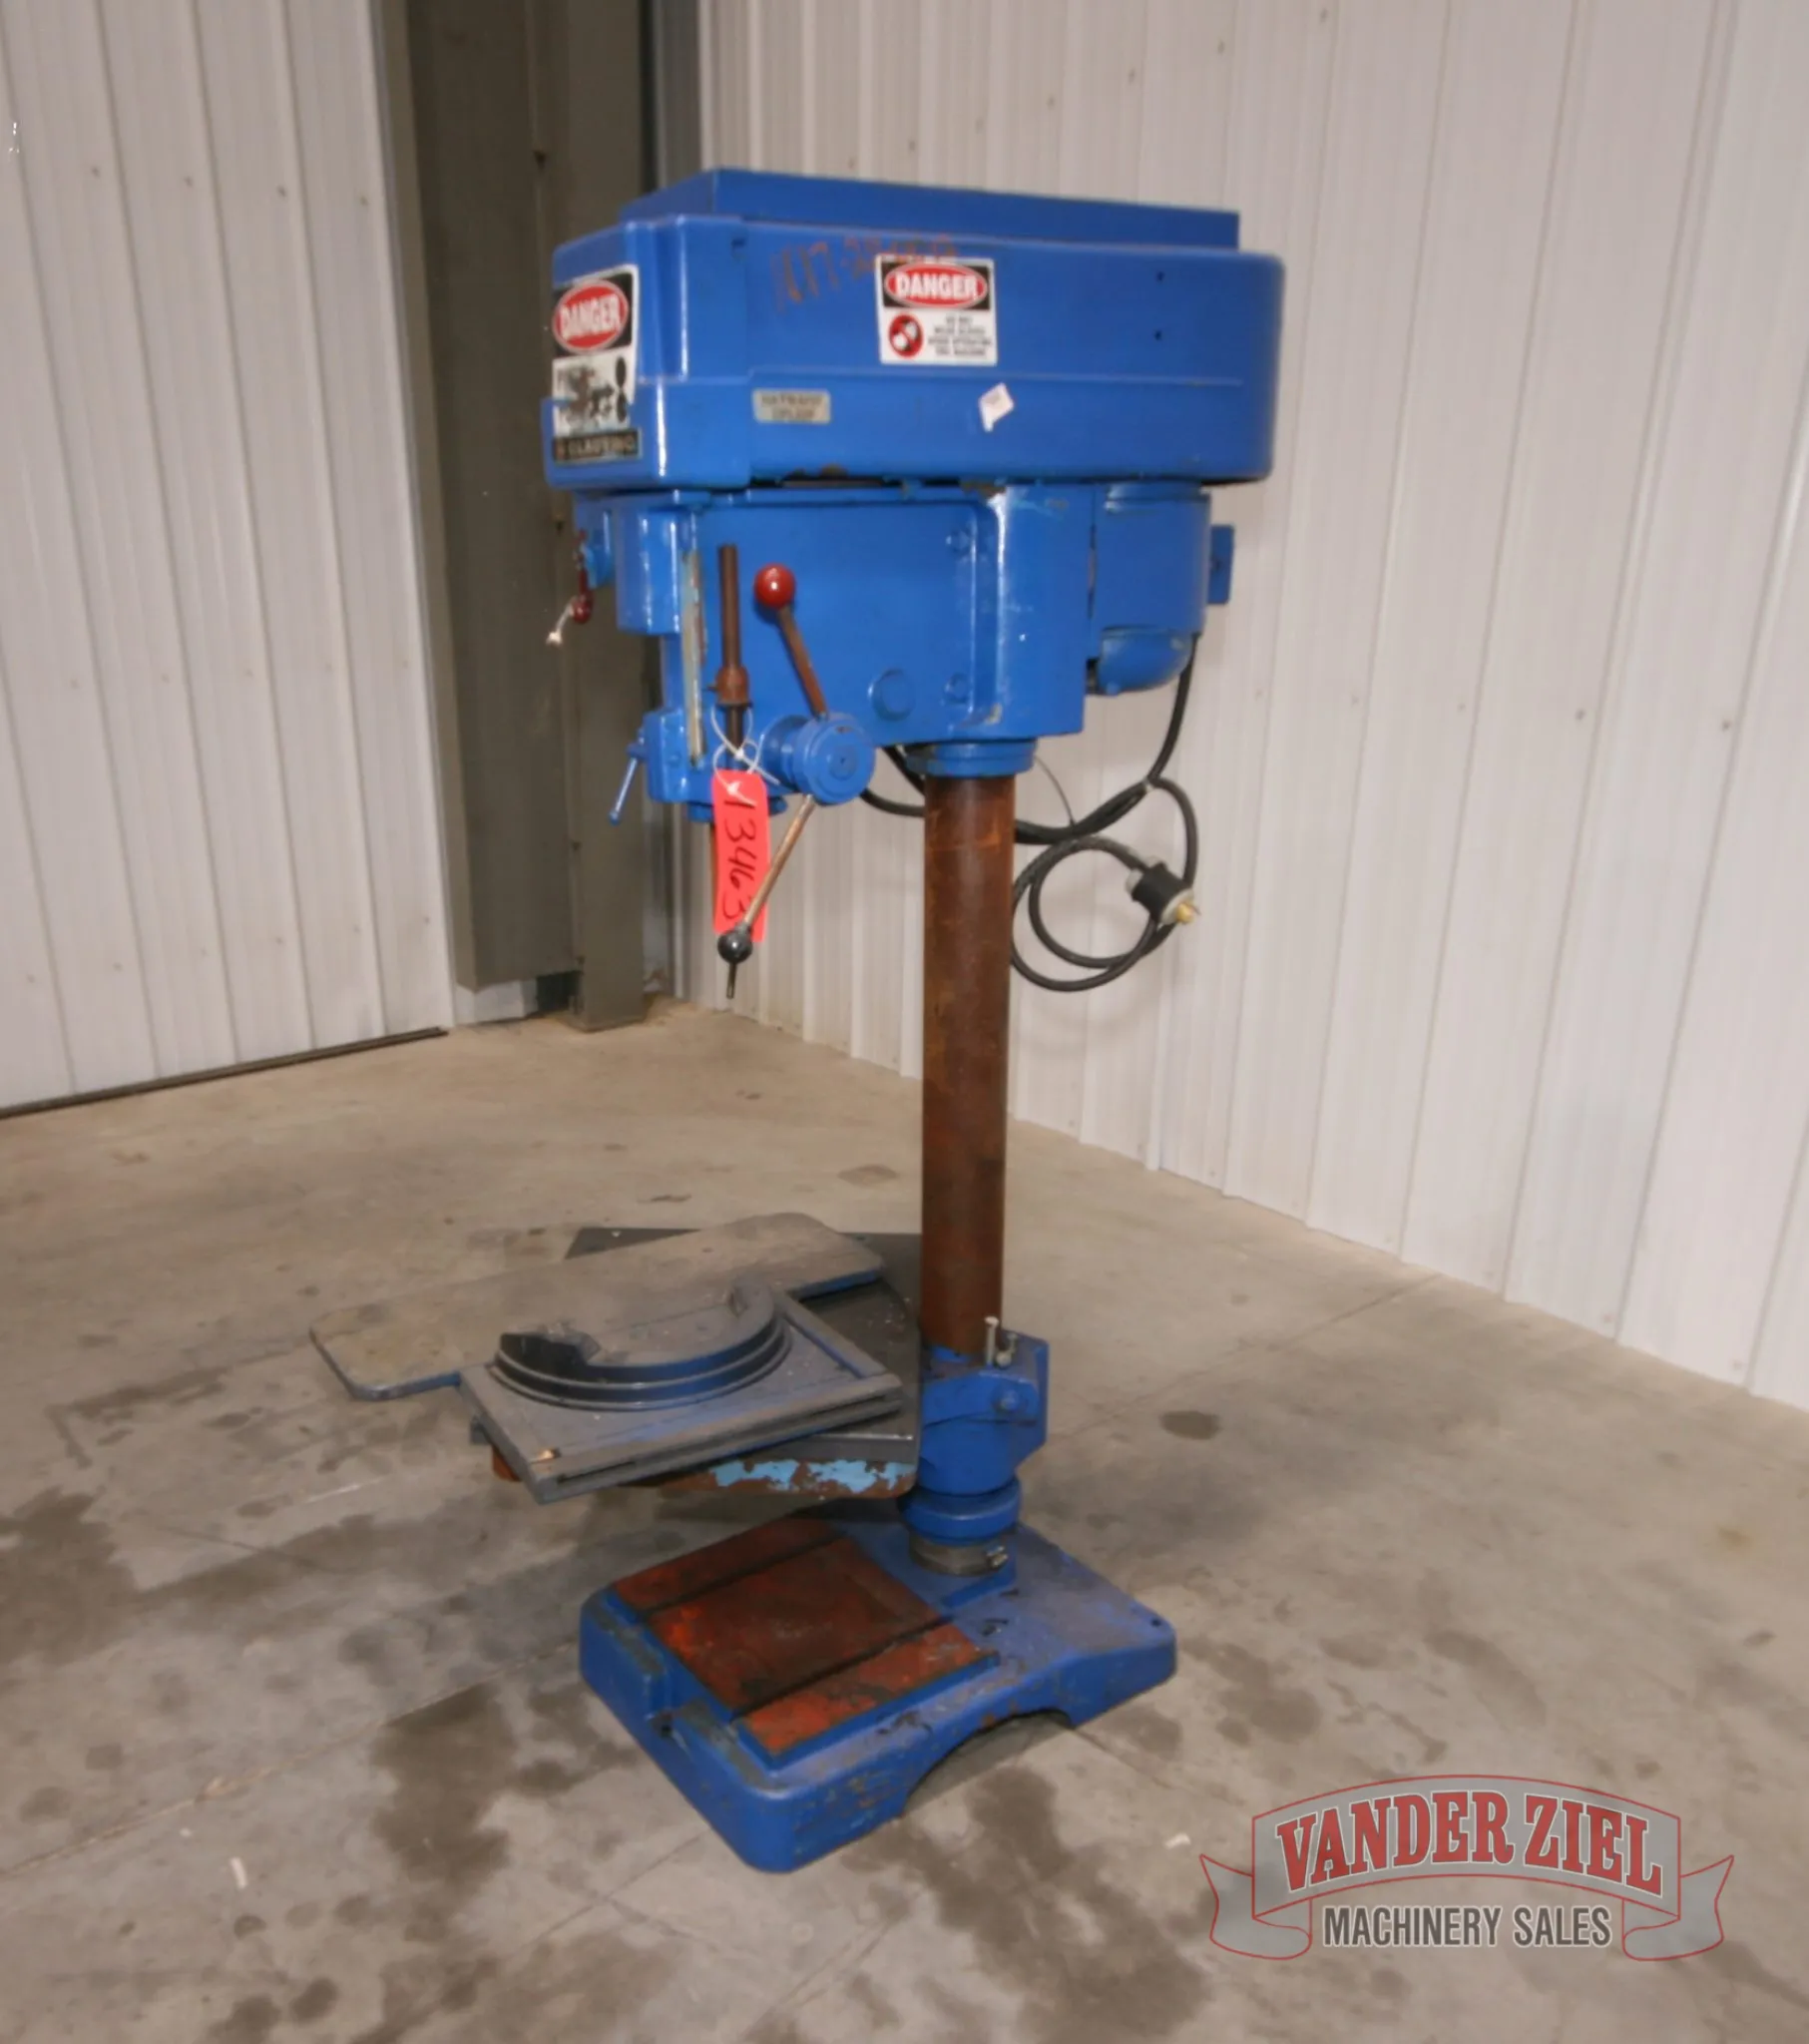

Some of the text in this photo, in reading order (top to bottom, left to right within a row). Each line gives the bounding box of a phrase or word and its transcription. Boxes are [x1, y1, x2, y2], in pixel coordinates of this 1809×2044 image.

[896, 270, 977, 300] DANGER
[561, 294, 620, 341] DANGER
[722, 800, 757, 920] 13463
